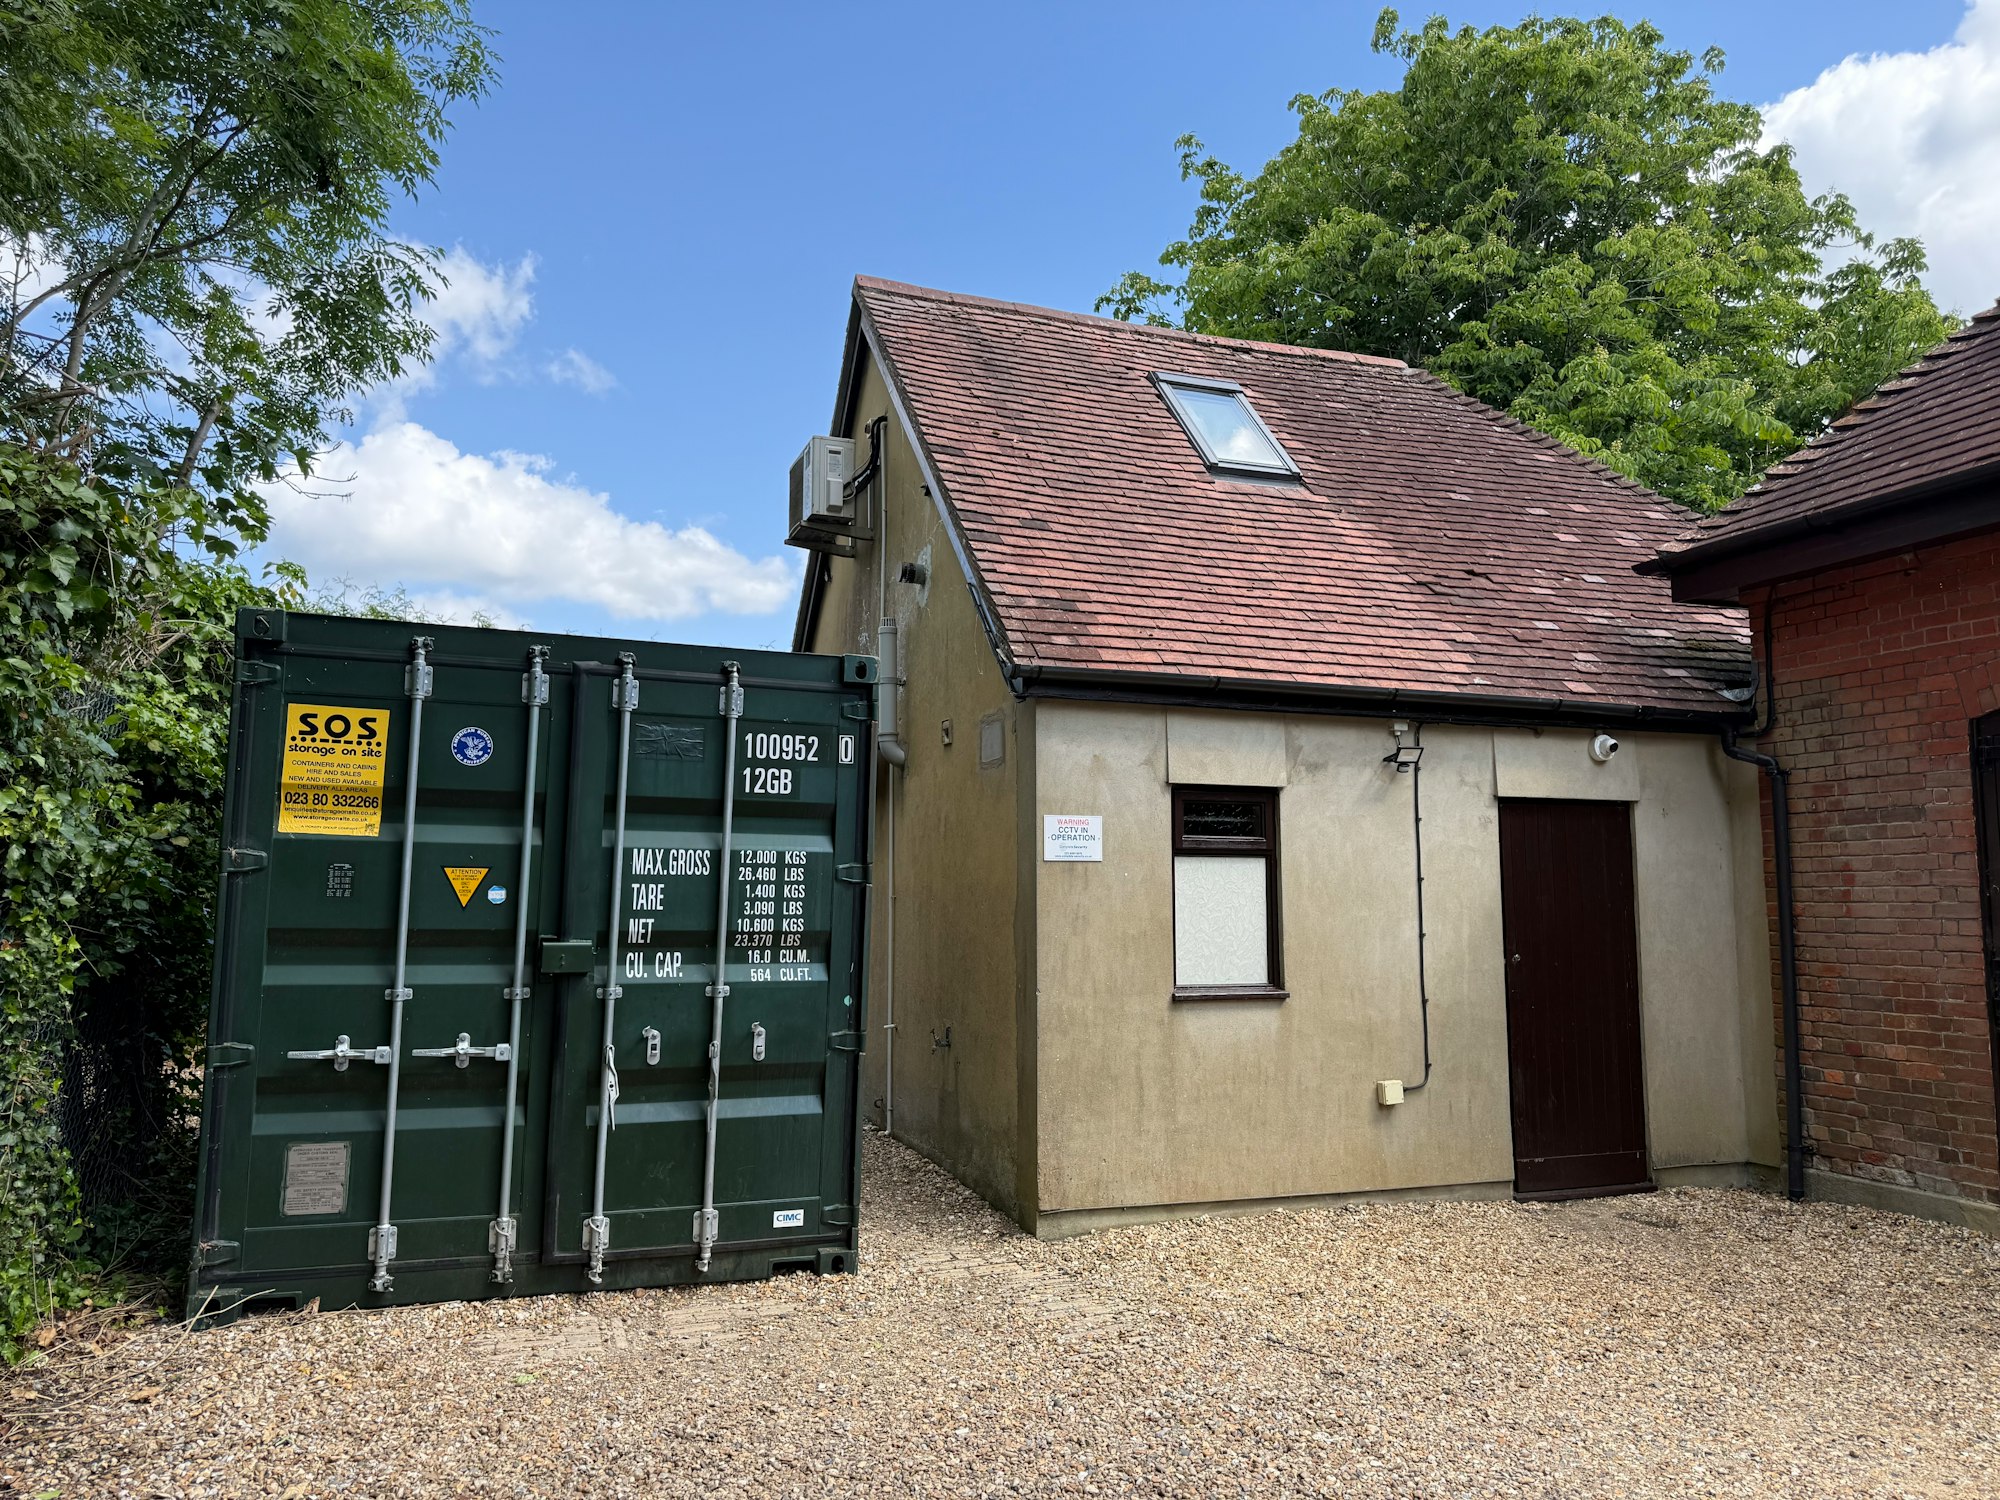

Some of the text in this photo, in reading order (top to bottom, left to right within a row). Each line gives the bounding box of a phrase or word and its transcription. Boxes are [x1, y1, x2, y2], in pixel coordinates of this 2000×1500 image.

[299, 713, 377, 740] SOS
[289, 744, 382, 758] storage on site
[745, 733, 852, 762] 100952 0
[292, 760, 334, 769] CONTAINERS
[743, 767, 792, 795] 12GB
[285, 792, 378, 809] 023 80 332266
[285, 806, 377, 816] enquiries@storageonsite.co.uk
[294, 814, 367, 822] www.storageonsite.co.uk
[740, 850, 807, 865] 12,000 KGS
[739, 867, 804, 881] 26,460 LBS
[632, 883, 664, 911] TARE
[746, 884, 805, 898] 1,400 KGS
[744, 901, 803, 915] 3,090 LBS
[628, 919, 654, 944] NET
[737, 918, 804, 932] 10,600 KGS
[734, 934, 801, 947] 23,370 LBS
[748, 949, 810, 964] 16.0 CU.M.
[626, 952, 683, 978] CU. CAP.
[751, 968, 811, 982] 564 CU.FT.
[777, 1213, 801, 1222] CIMC
